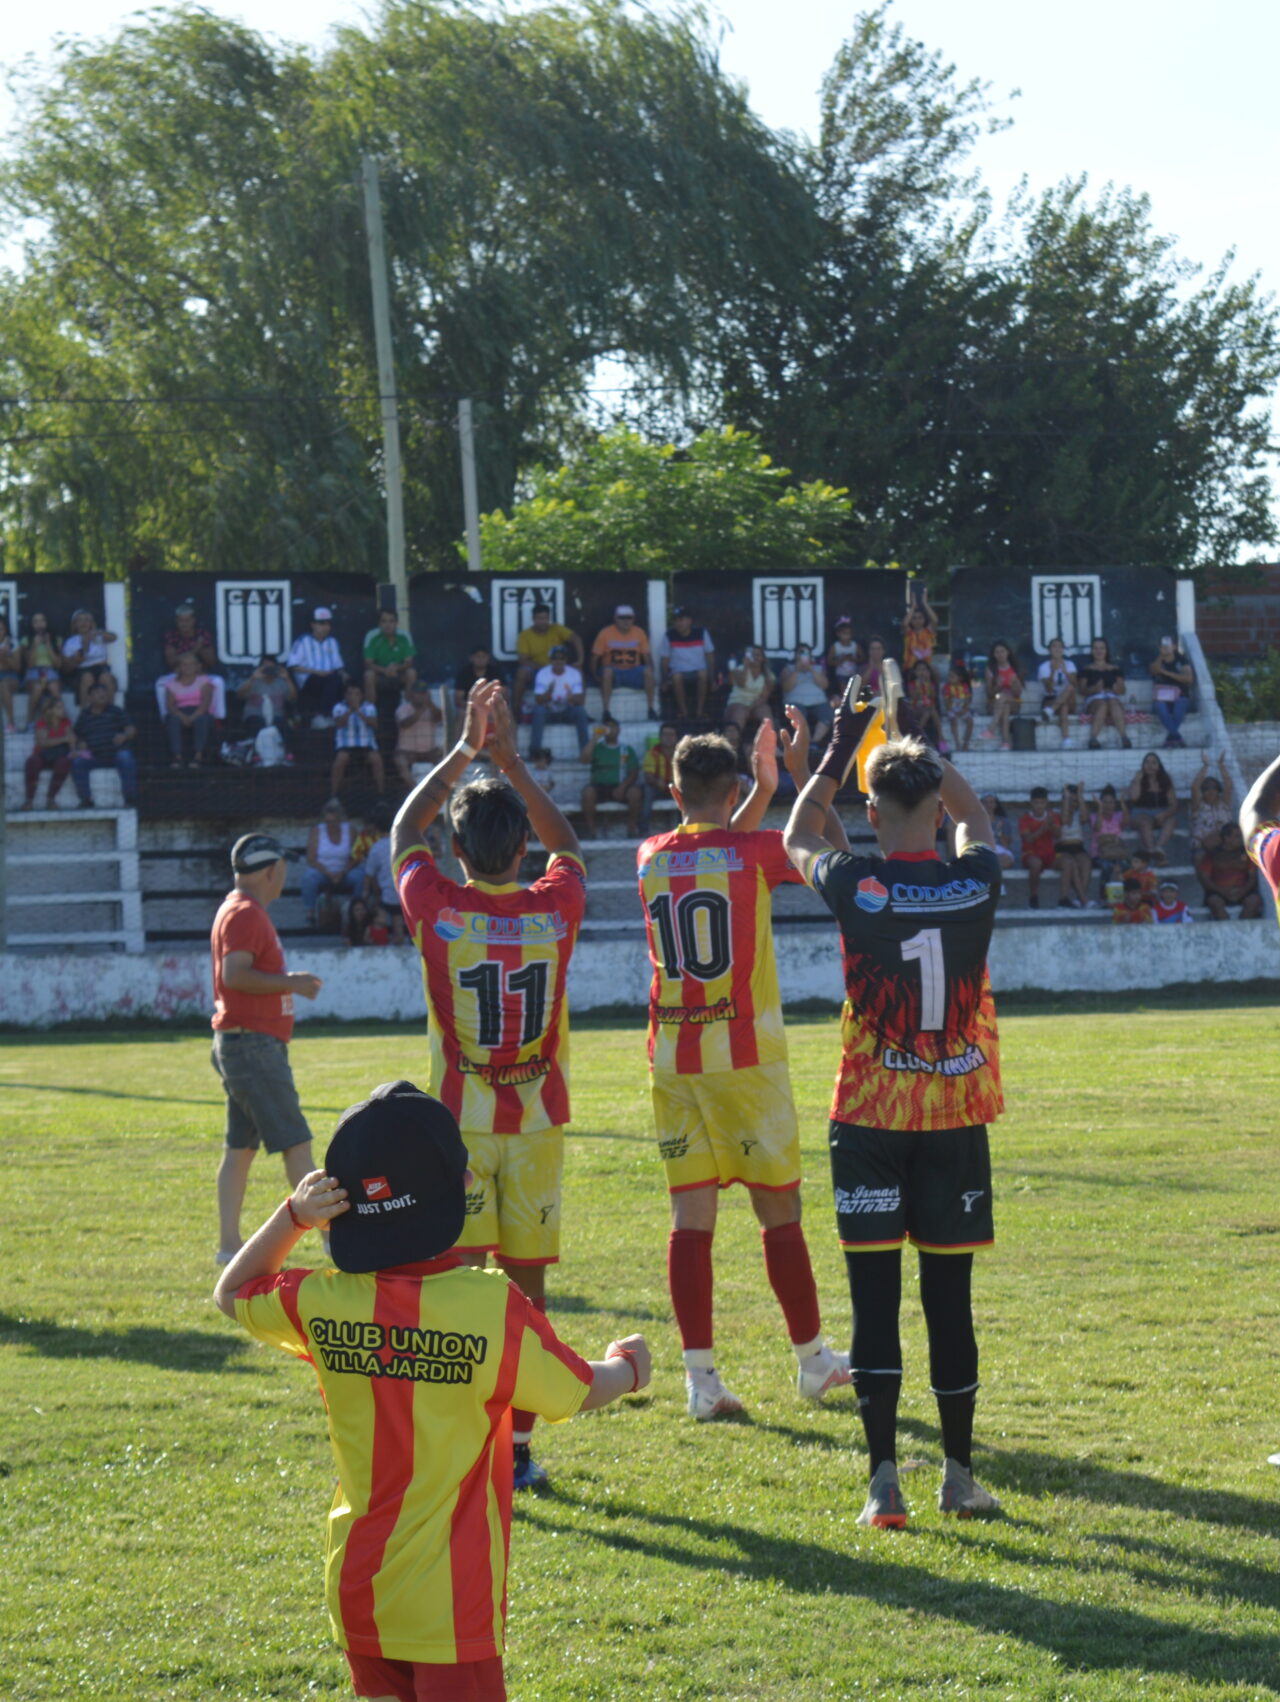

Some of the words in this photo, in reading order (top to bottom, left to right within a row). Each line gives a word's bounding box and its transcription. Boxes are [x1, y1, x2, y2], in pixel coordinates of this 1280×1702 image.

[654, 847, 744, 868] CODESAL
[892, 878, 991, 902] CODESAL
[471, 910, 568, 935] CODESAL
[647, 889, 733, 981] 10
[900, 928, 946, 1031] 1
[457, 960, 552, 1048] 11
[883, 1047, 934, 1074] CLUB
[357, 1202, 381, 1215] JUST
[309, 1317, 386, 1351] CLUB
[389, 1326, 488, 1365] UNION
[320, 1348, 383, 1377] VILLA
[385, 1355, 473, 1384] JARDIN
